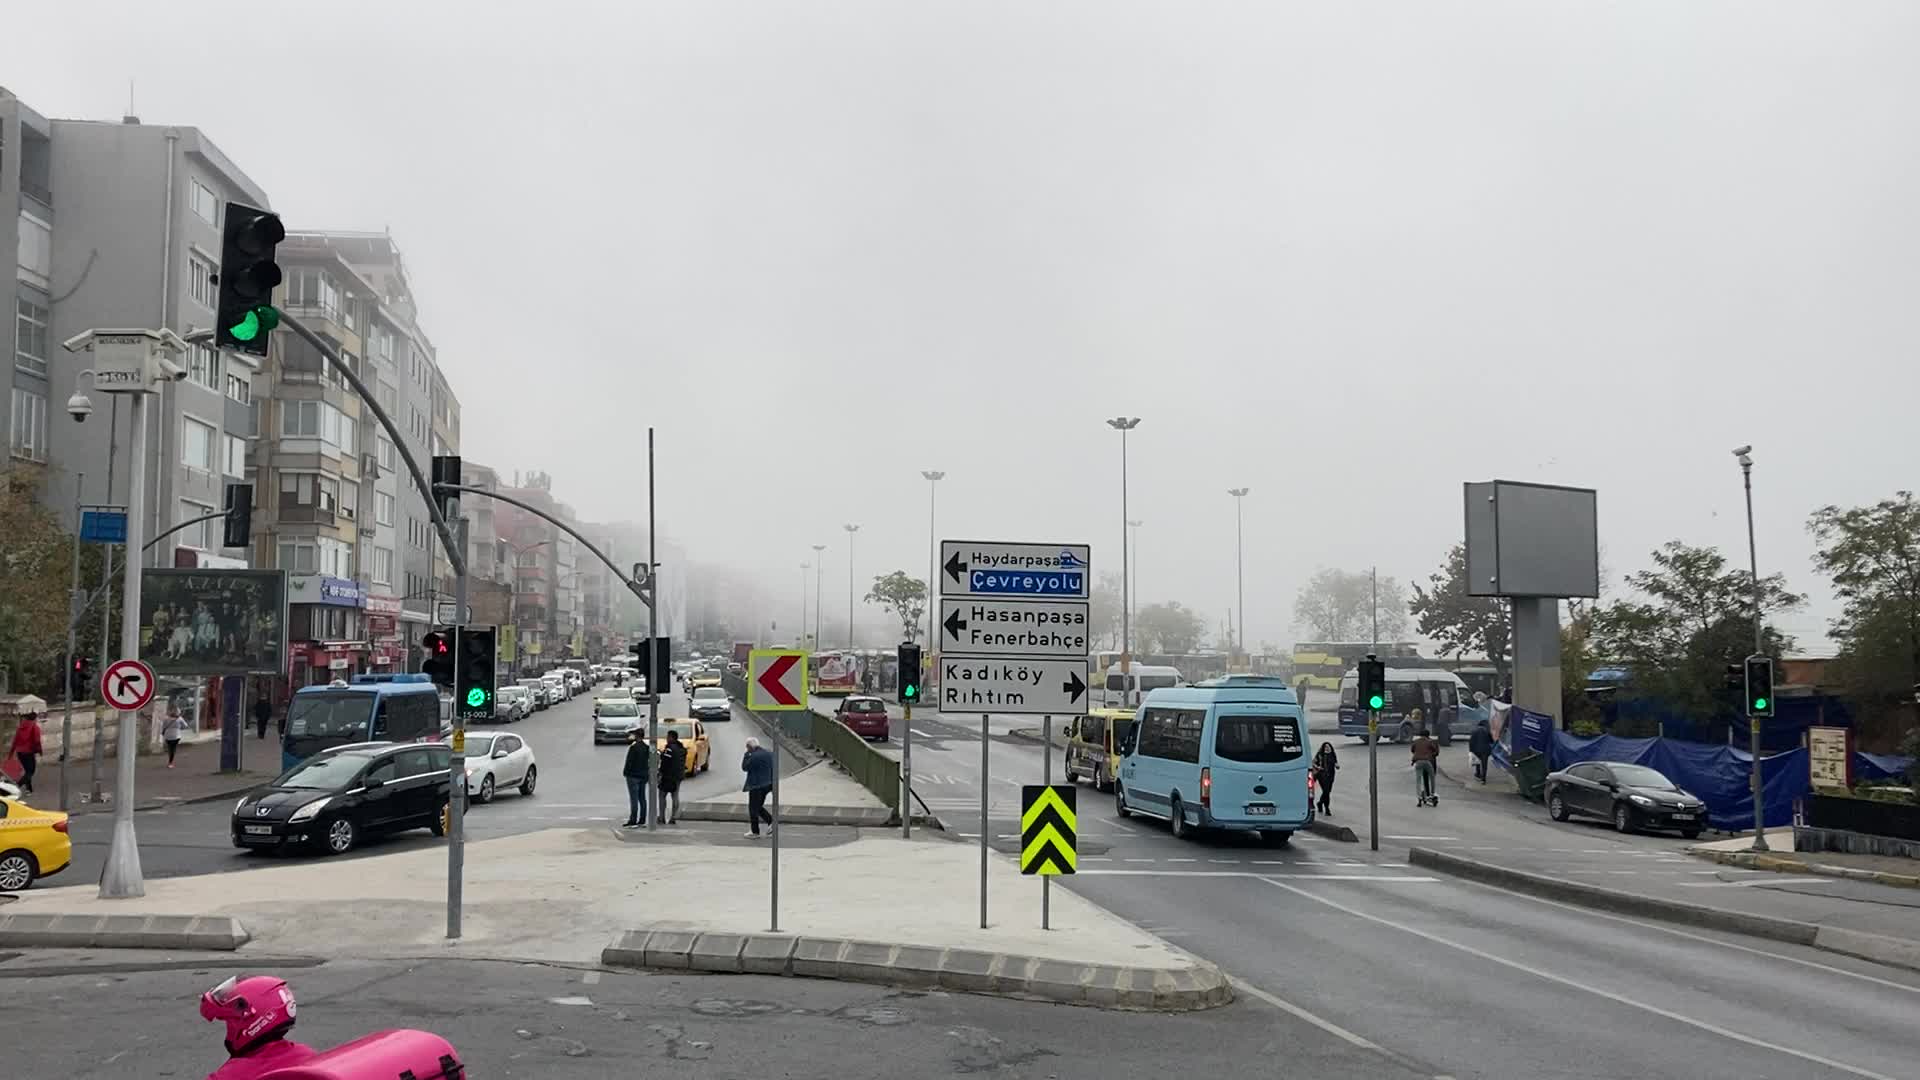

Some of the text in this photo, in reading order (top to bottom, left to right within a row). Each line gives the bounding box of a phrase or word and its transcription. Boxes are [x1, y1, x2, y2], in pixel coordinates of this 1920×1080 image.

[971, 552, 1060, 568] Haydarpaşa
[972, 571, 1081, 592] Çevreyolu
[971, 606, 1085, 627] Hasanpaşa
[971, 629, 1084, 648] Fenerbahçe
[946, 664, 1043, 686] Kadıköy
[946, 688, 1024, 705] Rıhtım
